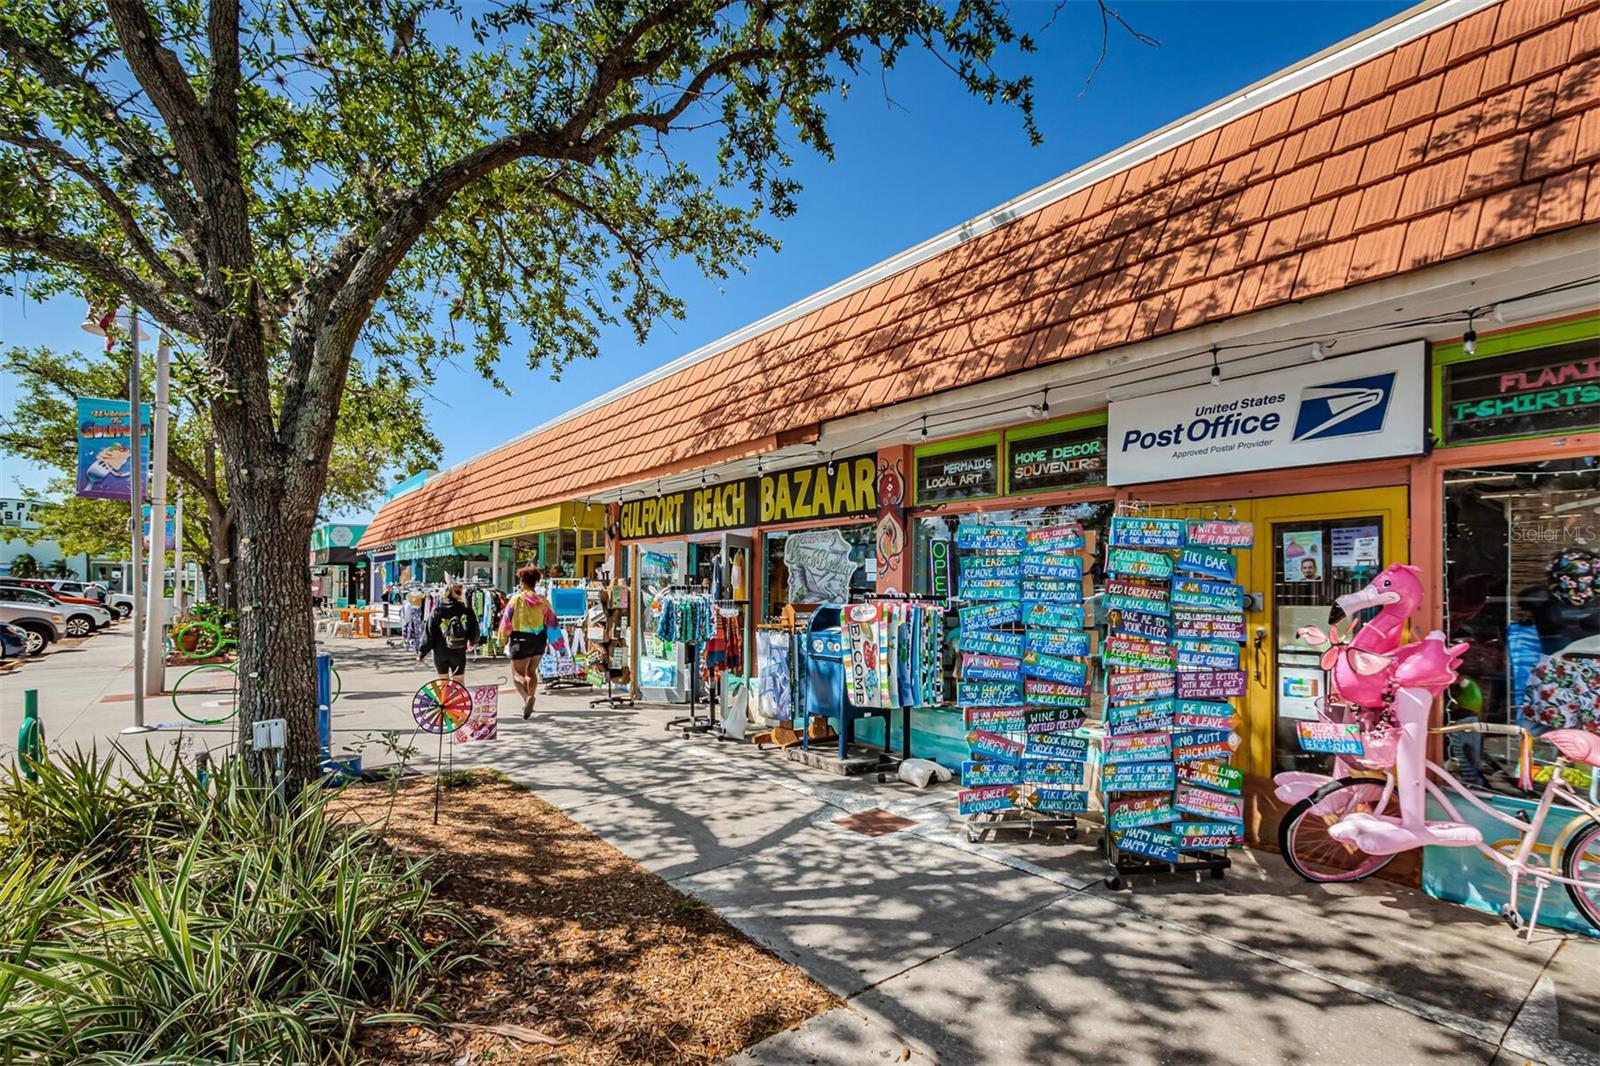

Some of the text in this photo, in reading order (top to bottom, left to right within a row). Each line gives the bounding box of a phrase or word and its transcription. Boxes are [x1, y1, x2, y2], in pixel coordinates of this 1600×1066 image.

[1501, 358, 1600, 392] FLAMI
[1195, 393, 1286, 417] United States
[1453, 385, 1600, 421] T-SHIRTS
[1122, 412, 1281, 452] Post Office
[1015, 440, 1101, 464] HOME DECOR
[1172, 439, 1273, 459] Approved Postal Provider
[943, 458, 992, 474] MERMAIDS
[1014, 457, 1101, 479] SOUVENIRS
[926, 473, 982, 489] LOCAL ART
[620, 458, 877, 538] GULFPORT BEACH BAZAAR
[1199, 523, 1240, 535] WIPE YOUR
[1207, 535, 1231, 545] FLOPS
[1231, 536, 1251, 546] HERE
[975, 556, 1007, 568] PLEASE
[1183, 550, 1227, 571] TIKI BAR
[964, 565, 1020, 579] REMOVE SHOES
[1024, 564, 1078, 578] STOLE MY DATE
[1023, 581, 1035, 590] THE
[1036, 581, 1058, 591] OCEAN
[1109, 583, 1165, 600] BED BREAKFAST
[1186, 582, 1199, 593] AIM
[1211, 585, 1238, 597] PLEASE
[1024, 590, 1078, 601] ONLY MEDICATION
[1213, 596, 1238, 608] PLEASE
[1146, 602, 1166, 612] BOTH
[1121, 609, 1139, 621] TAKE
[1140, 614, 1152, 625] ME
[1124, 621, 1168, 639] YOUR LITER
[964, 638, 990, 651] PLANT
[998, 645, 1019, 655] MAN
[850, 624, 865, 704] ELCOME
[967, 657, 1001, 669] MY WAY
[1039, 656, 1081, 674] DROP YOUR
[1191, 654, 1234, 666] GET CAUGHT
[982, 668, 1018, 680] HIGHWAY
[1052, 670, 1073, 683] HERE
[1181, 672, 1240, 681] WINE GETS BETTER
[1031, 683, 1083, 696] NUDE BEACH
[1182, 680, 1237, 689] WITH GET
[1184, 689, 1207, 698] BETTER
[1209, 688, 1224, 696] WITH
[1030, 709, 1069, 723] WINE IS
[1182, 702, 1223, 717] BE NICE
[1027, 718, 1081, 734] BOTTLED POETRY
[1179, 715, 1224, 728] OR LEAVE
[1043, 736, 1060, 745] COOK
[1067, 738, 1085, 748] FRIED
[1180, 731, 1221, 747] NO BUTT
[1005, 745, 1019, 758] UP
[1031, 743, 1083, 758] ORDER TAKEOUT
[1179, 744, 1222, 759] SUCKING
[1190, 760, 1240, 779] NOT YELLING
[1190, 771, 1230, 788] JAMAICAN
[962, 787, 1007, 803] HOME SWEET
[1042, 790, 1081, 801] TIKI BAR
[969, 799, 1000, 813] CONDO
[1038, 800, 1084, 811] ALWAYS OPEN
[1134, 801, 1148, 810] OUT
[1125, 827, 1171, 846] HAPPY WIFE
[1211, 825, 1238, 835] SHAPE
[1121, 838, 1170, 858] HAPPY LIFE
[1191, 836, 1233, 847] EXERCISE
